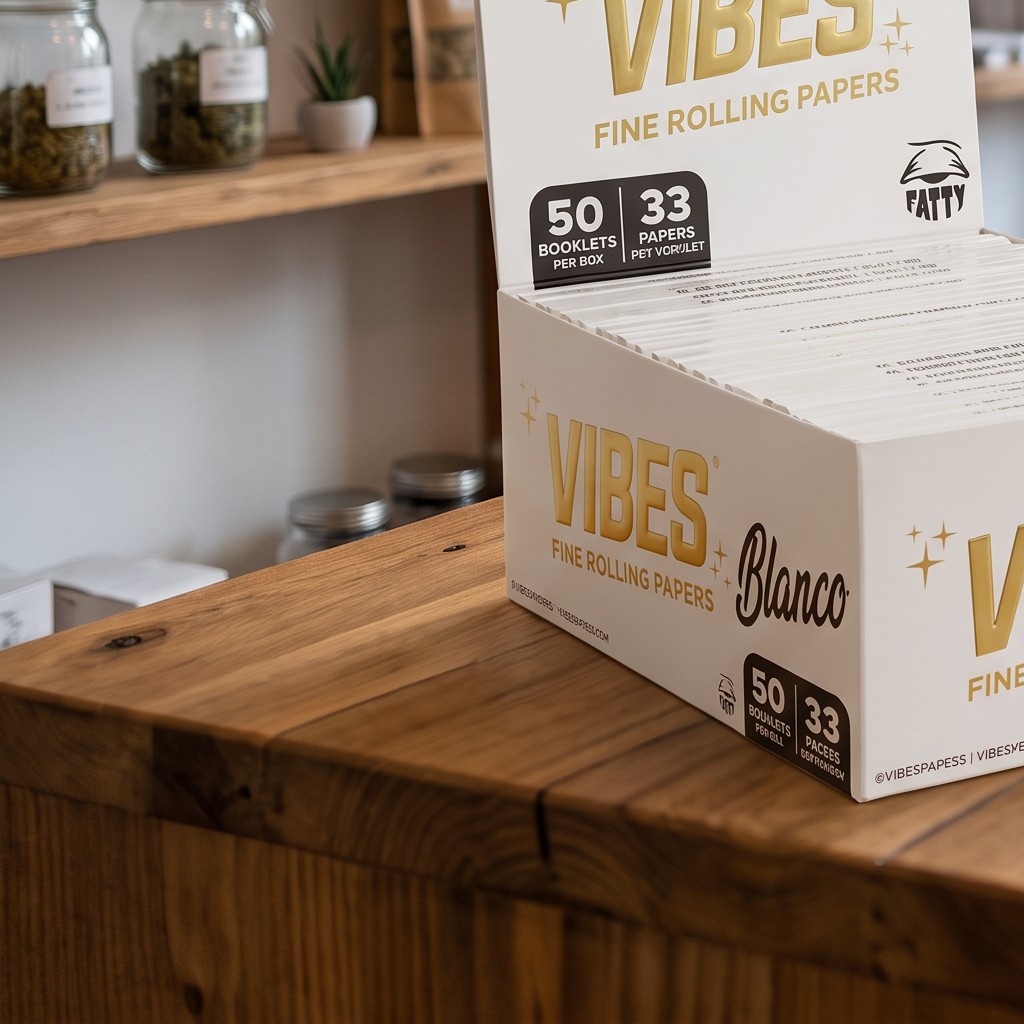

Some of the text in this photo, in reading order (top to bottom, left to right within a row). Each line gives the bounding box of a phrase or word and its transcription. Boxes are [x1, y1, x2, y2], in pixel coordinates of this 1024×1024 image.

[594, 68, 900, 149] FINE ROLLING PAPERS
[548, 196, 604, 236] 50
[640, 185, 691, 225] 33
[906, 184, 965, 221] FATTY
[538, 235, 617, 257] BOOKLETS
[639, 226, 695, 244] PAPERS
[553, 254, 604, 270] PER BOX
[546, 412, 709, 568] VIBES
[552, 537, 714, 612] FINE ROLLING PAPERS
[735, 522, 848, 629] Blanco
[752, 667, 785, 714] 50
[804, 696, 840, 744] 33
